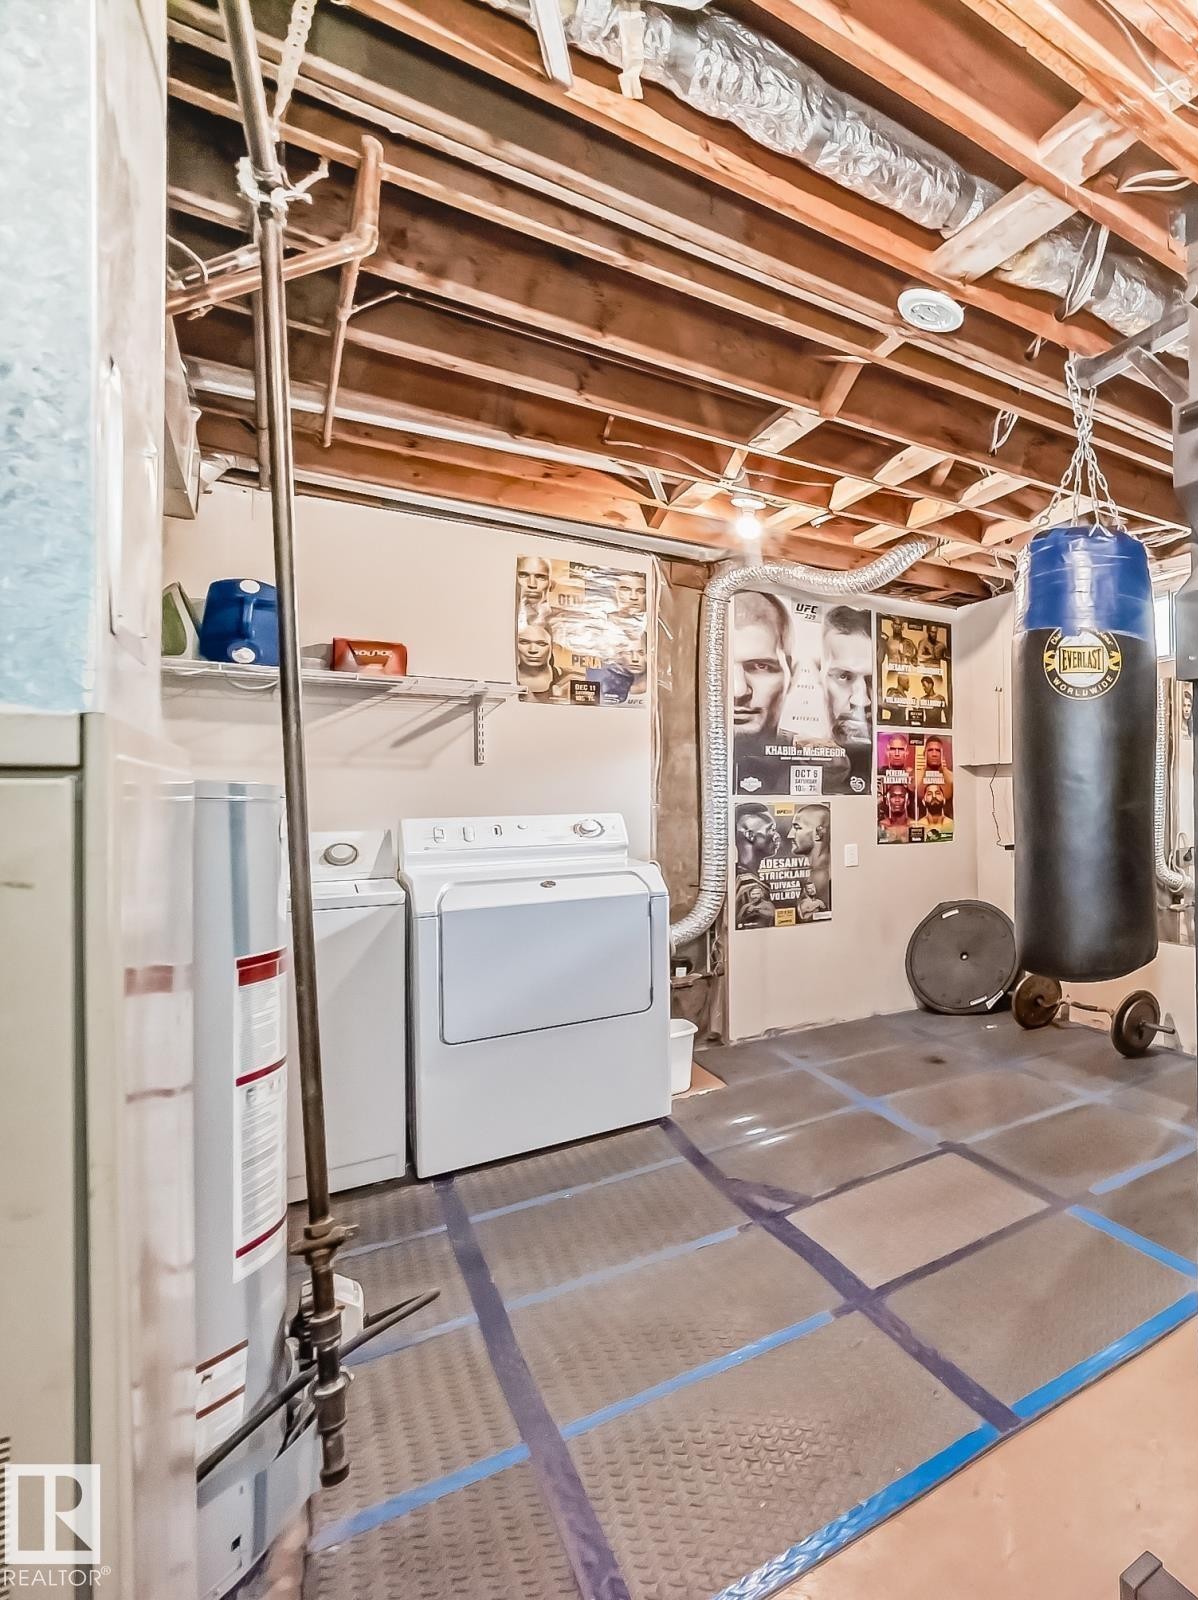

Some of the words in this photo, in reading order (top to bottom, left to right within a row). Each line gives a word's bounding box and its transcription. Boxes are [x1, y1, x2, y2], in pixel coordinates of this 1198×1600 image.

[796, 603, 818, 614] UFC
[1062, 649, 1101, 671] EVERLAST
[1053, 675, 1114, 697] WORLDWIDE
[765, 745, 797, 756] KHABIB
[795, 769, 811, 778] OCT
[759, 856, 811, 869] ADESANYA
[759, 869, 811, 881] STRICKLAND
[770, 881, 801, 890] TUIVASA
[770, 891, 801, 901] VOLKOV
